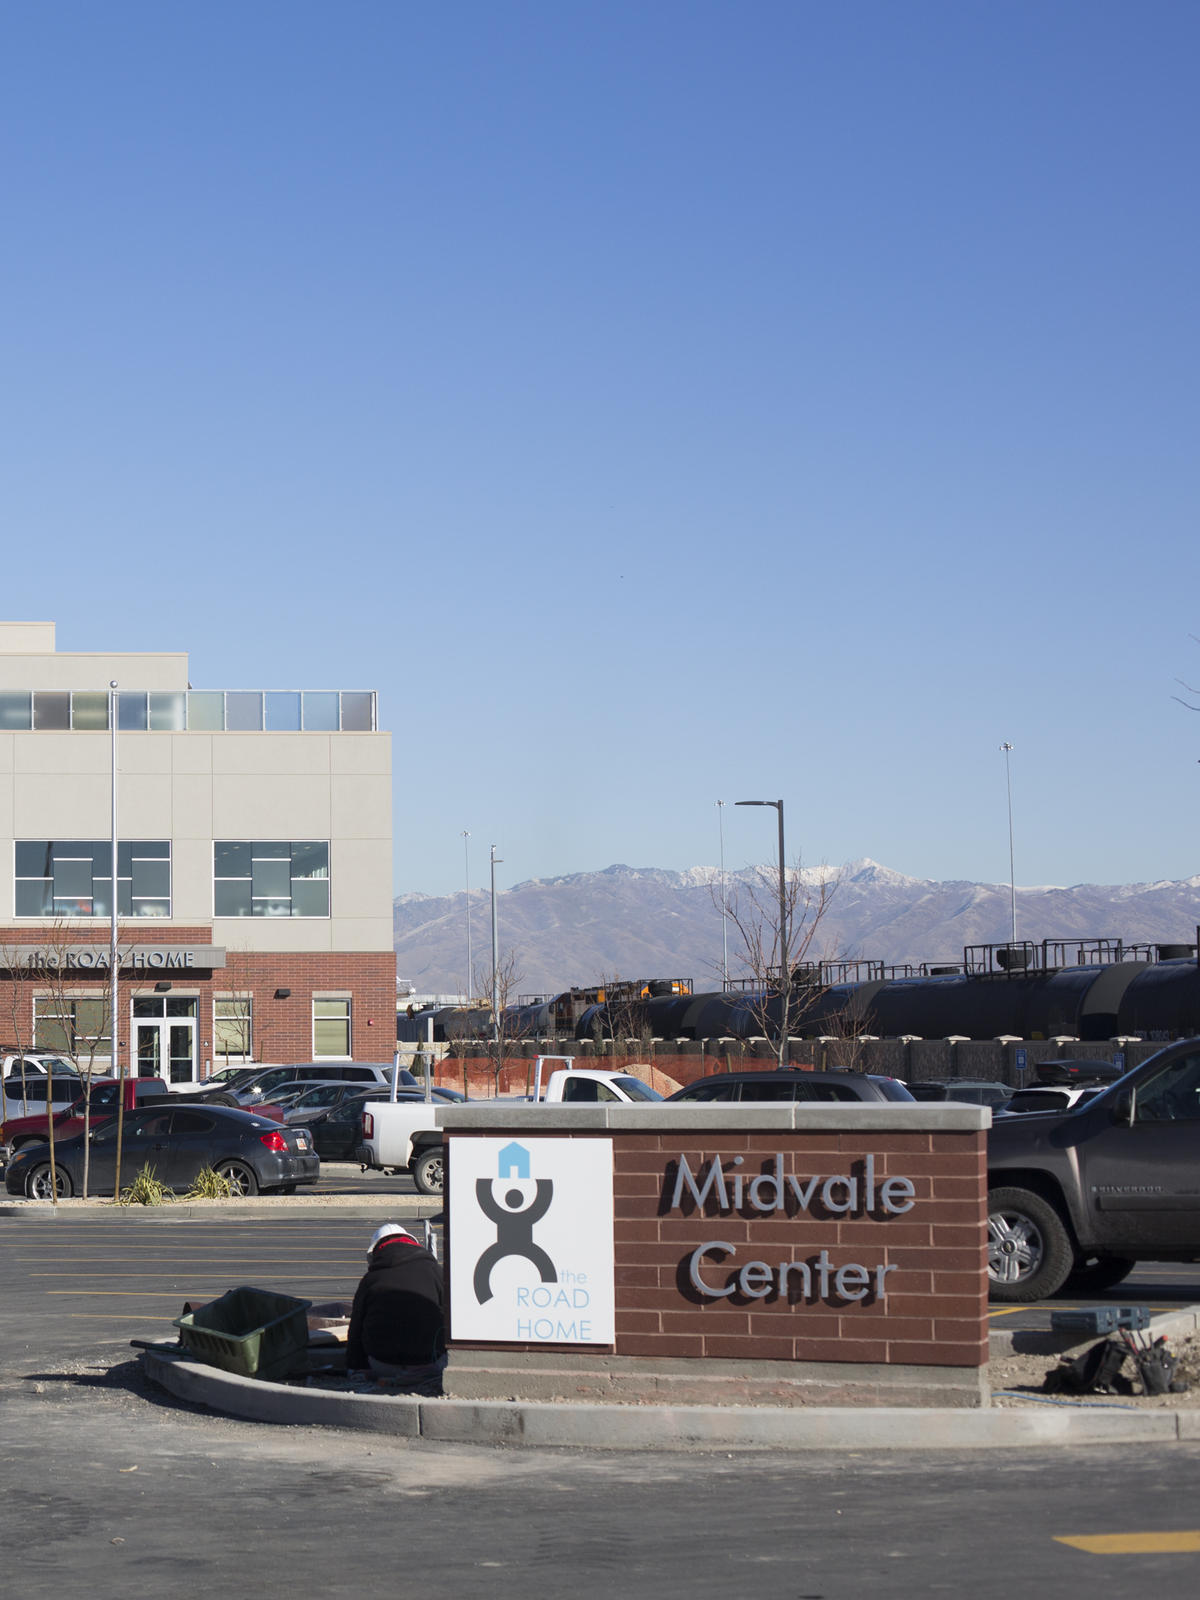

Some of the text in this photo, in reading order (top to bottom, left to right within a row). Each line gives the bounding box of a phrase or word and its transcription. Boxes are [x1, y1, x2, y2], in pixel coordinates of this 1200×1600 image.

[28, 951, 58, 969] the
[132, 952, 194, 968] HOME
[671, 1153, 916, 1213] Midvale
[560, 1269, 588, 1284] the
[689, 1241, 898, 1300] Center
[516, 1287, 590, 1309] ROAD
[516, 1318, 592, 1340] HOME
